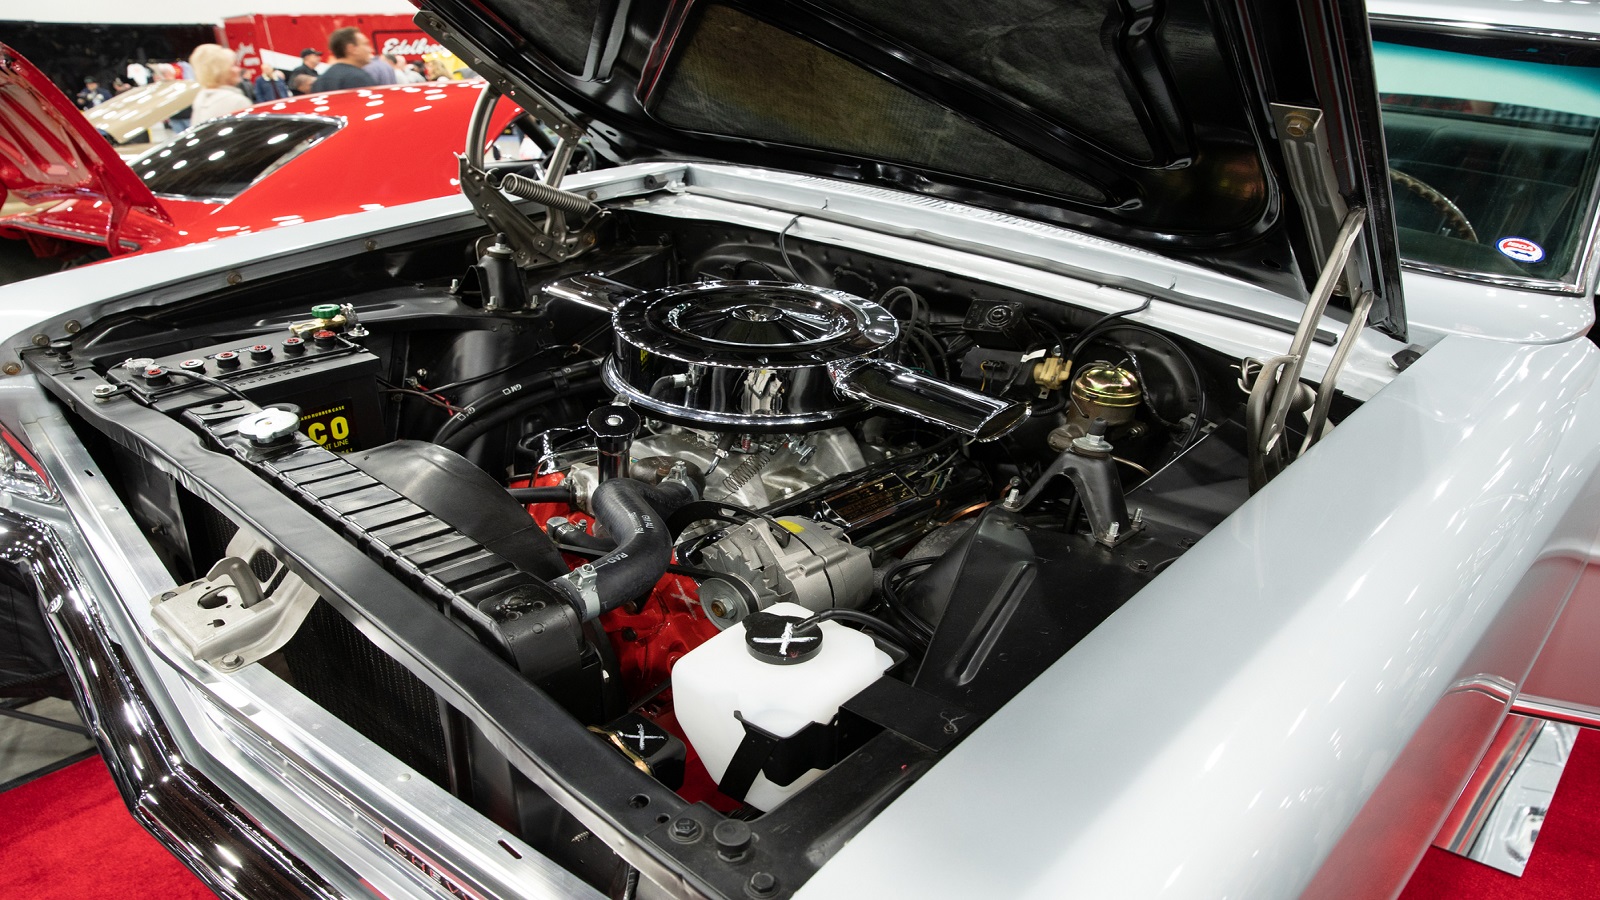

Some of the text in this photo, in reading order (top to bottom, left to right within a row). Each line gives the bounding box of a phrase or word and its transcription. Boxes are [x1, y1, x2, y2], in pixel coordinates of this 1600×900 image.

[382, 37, 443, 55] Edelbro
[311, 408, 332, 418] RUBBER
[332, 405, 345, 413] CASE
[334, 439, 349, 448] LINE
[607, 552, 628, 564] RAD
